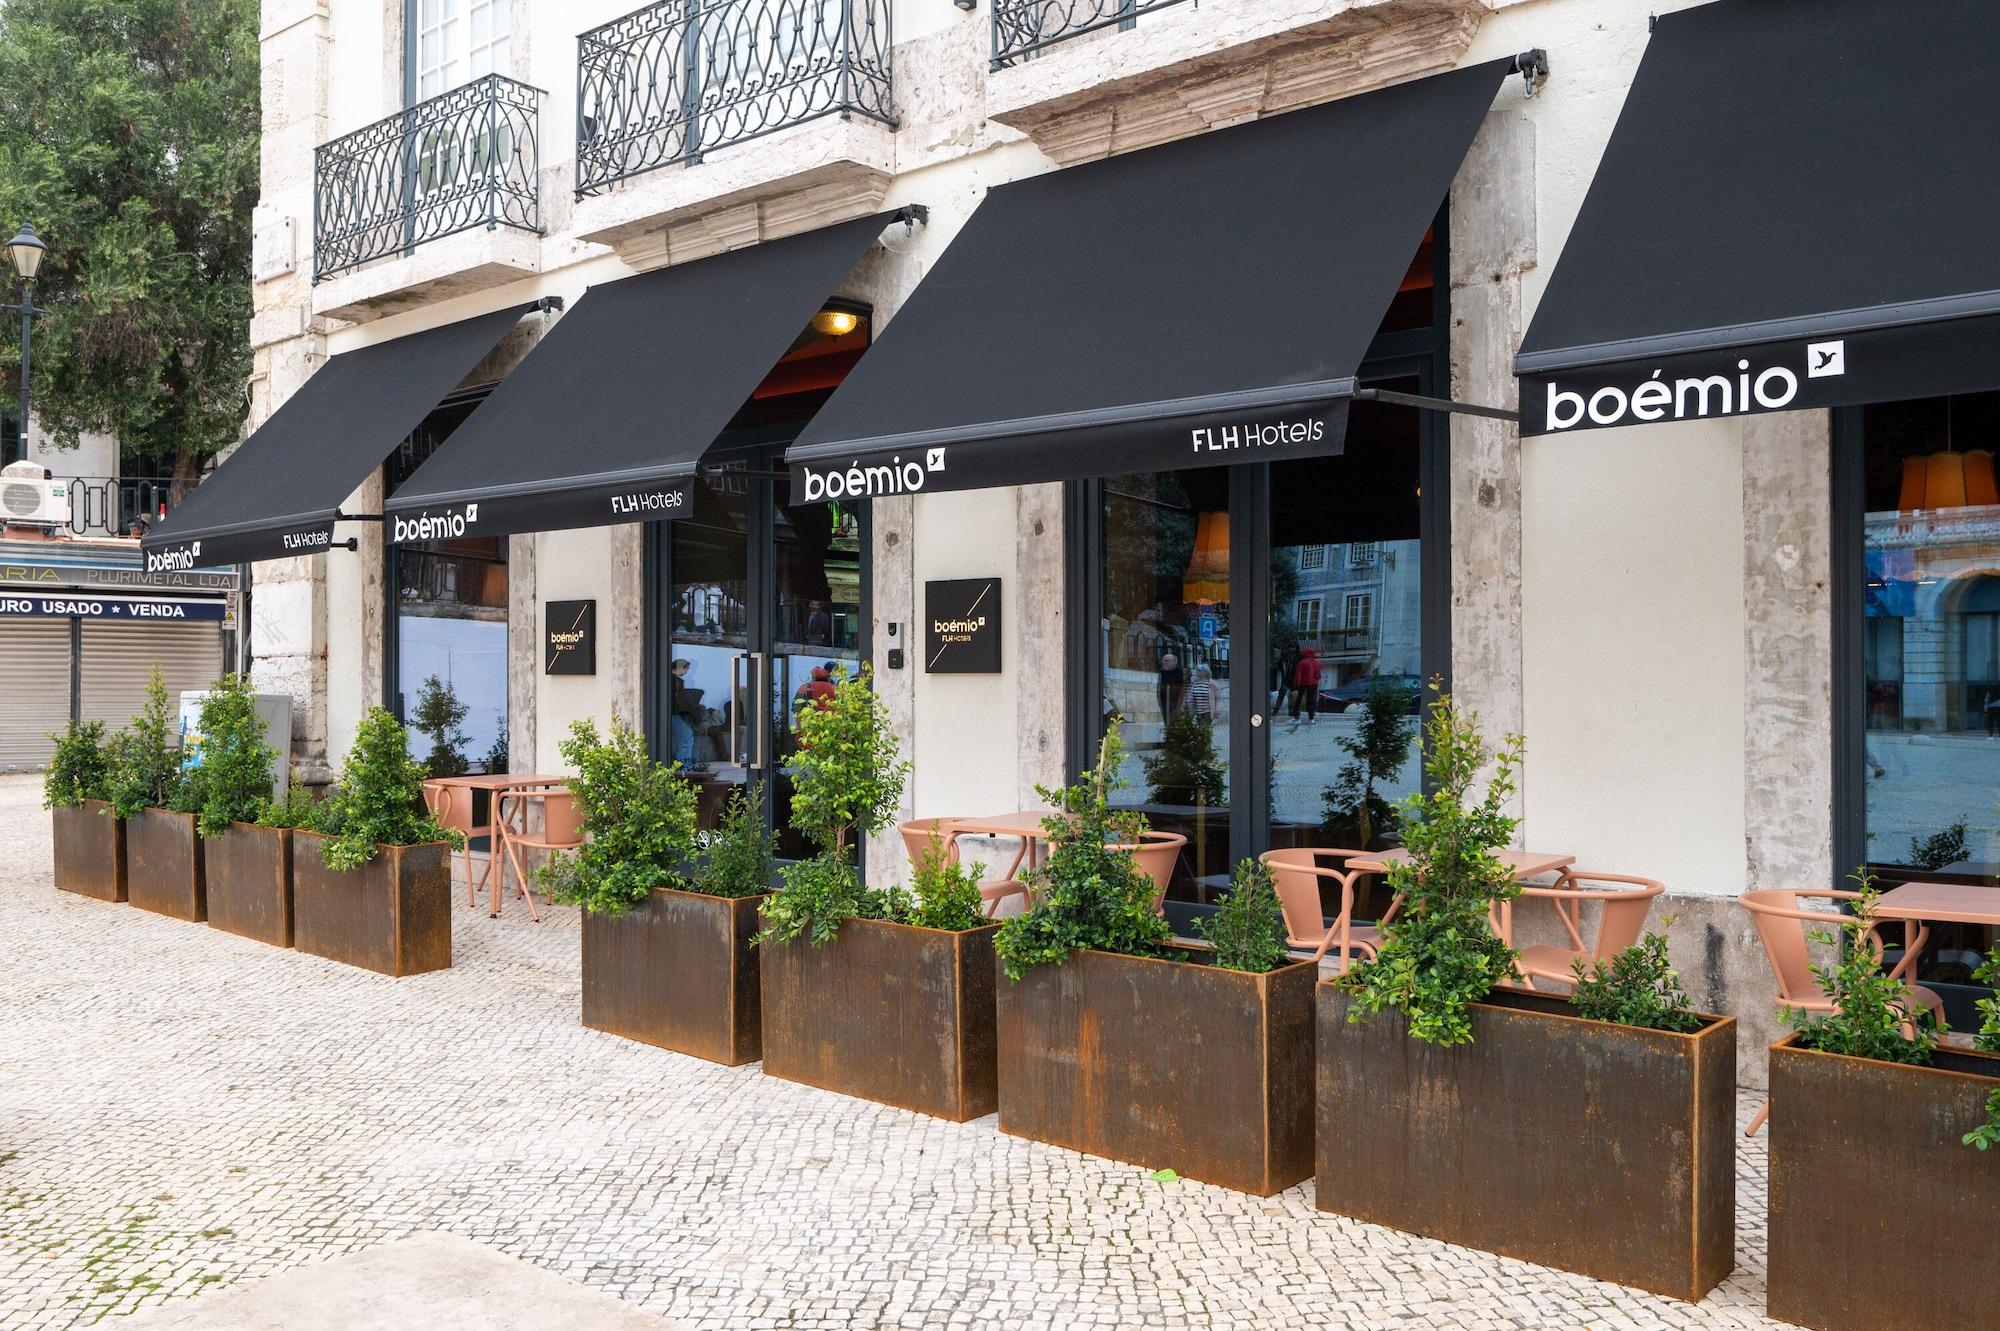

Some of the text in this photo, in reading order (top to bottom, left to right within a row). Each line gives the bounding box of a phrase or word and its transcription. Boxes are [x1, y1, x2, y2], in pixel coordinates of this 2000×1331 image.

[1546, 359, 1798, 431] boémio
[1191, 418, 1324, 453] FLH Hotels
[804, 456, 924, 502] boémio
[611, 490, 683, 514] FLH Hotels
[394, 509, 465, 542] boémio
[283, 530, 329, 549] FLH Hotels
[147, 546, 194, 572] boémio
[87, 569, 193, 586] PLURIMETAL
[199, 575, 231, 588] LDA
[42, 600, 103, 615] USADO
[128, 603, 185, 618] VENDA
[551, 631, 579, 643] boémio
[934, 619, 978, 633] boémio
